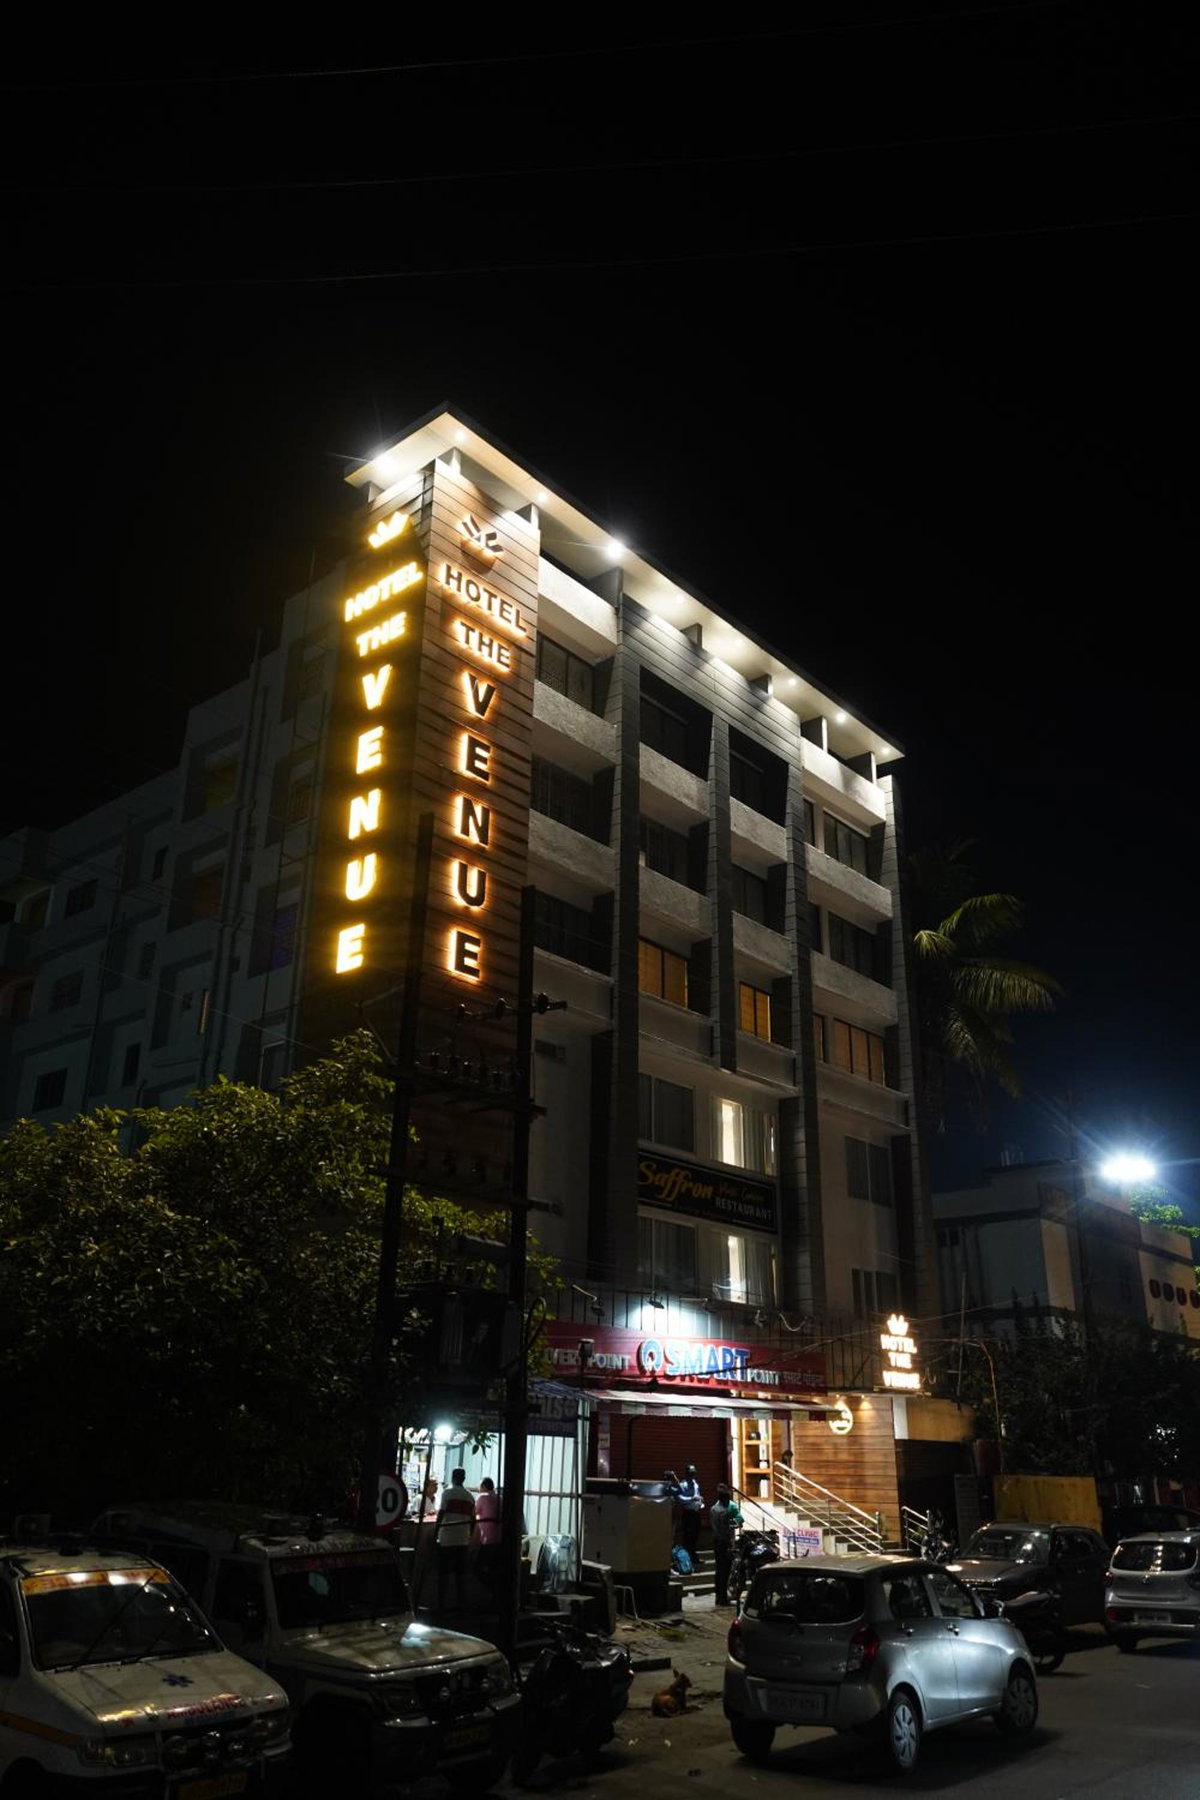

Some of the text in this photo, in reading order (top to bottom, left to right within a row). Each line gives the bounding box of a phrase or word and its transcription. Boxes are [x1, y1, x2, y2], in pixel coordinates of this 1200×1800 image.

[344, 562, 423, 623] HOTEL
[444, 563, 527, 631] HOTEL
[357, 611, 408, 658] THE
[458, 619, 511, 672] THE
[336, 664, 393, 975] VENUE
[452, 672, 496, 980] VENUE
[639, 1160, 714, 1201] Saffron
[715, 1197, 773, 1220] RESTAURANT
[587, 1352, 631, 1370] POINT
[664, 1340, 780, 1386] SMART POINT
[880, 1334, 917, 1353] HOTEL
[888, 1352, 912, 1368] THE
